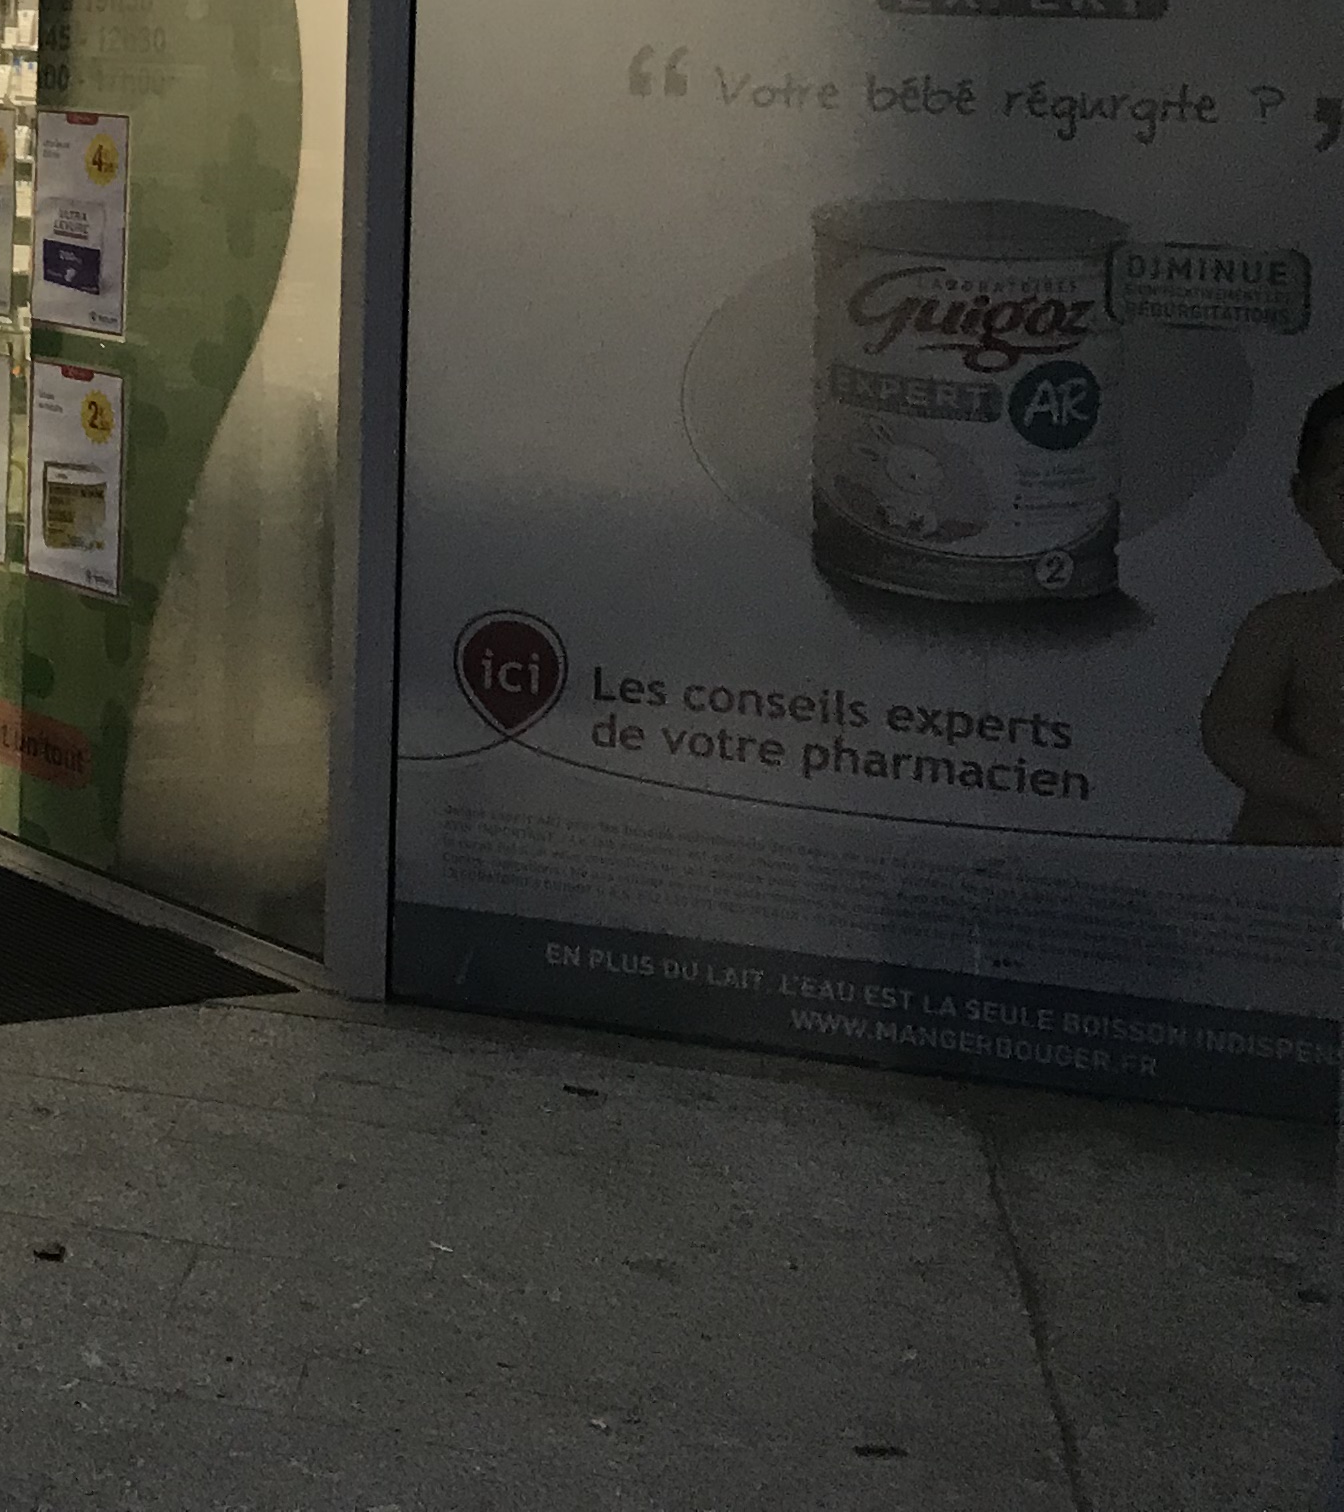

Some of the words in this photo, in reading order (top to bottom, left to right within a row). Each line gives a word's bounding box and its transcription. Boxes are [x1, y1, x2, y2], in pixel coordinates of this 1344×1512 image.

[714, 65, 842, 111] Votre
[865, 71, 978, 115] bébé
[1002, 82, 1219, 144] régurgite
[1126, 253, 1289, 287] DIMINUE
[848, 265, 1096, 374] Guigoz
[833, 367, 992, 415] EXPERT
[1023, 377, 1091, 428] AR
[1045, 555, 1067, 583] 2
[480, 648, 543, 697] ici
[592, 666, 667, 710] Les
[683, 678, 868, 731] conseils
[886, 699, 1074, 752] experts
[591, 713, 646, 753] de
[661, 725, 786, 769] votre
[802, 736, 1093, 802] pharmacien
[545, 941, 582, 969] EN
[588, 948, 655, 980] PLUS
[663, 957, 699, 982] DU
[777, 972, 855, 1005] L'EAU
[863, 982, 914, 1012] EST
[923, 990, 957, 1017] LA
[965, 996, 1055, 1033] SEULE
[1063, 1009, 1189, 1050] BOISSON
[791, 1007, 1158, 1080] WWW.MANGERBOUGER.FR
